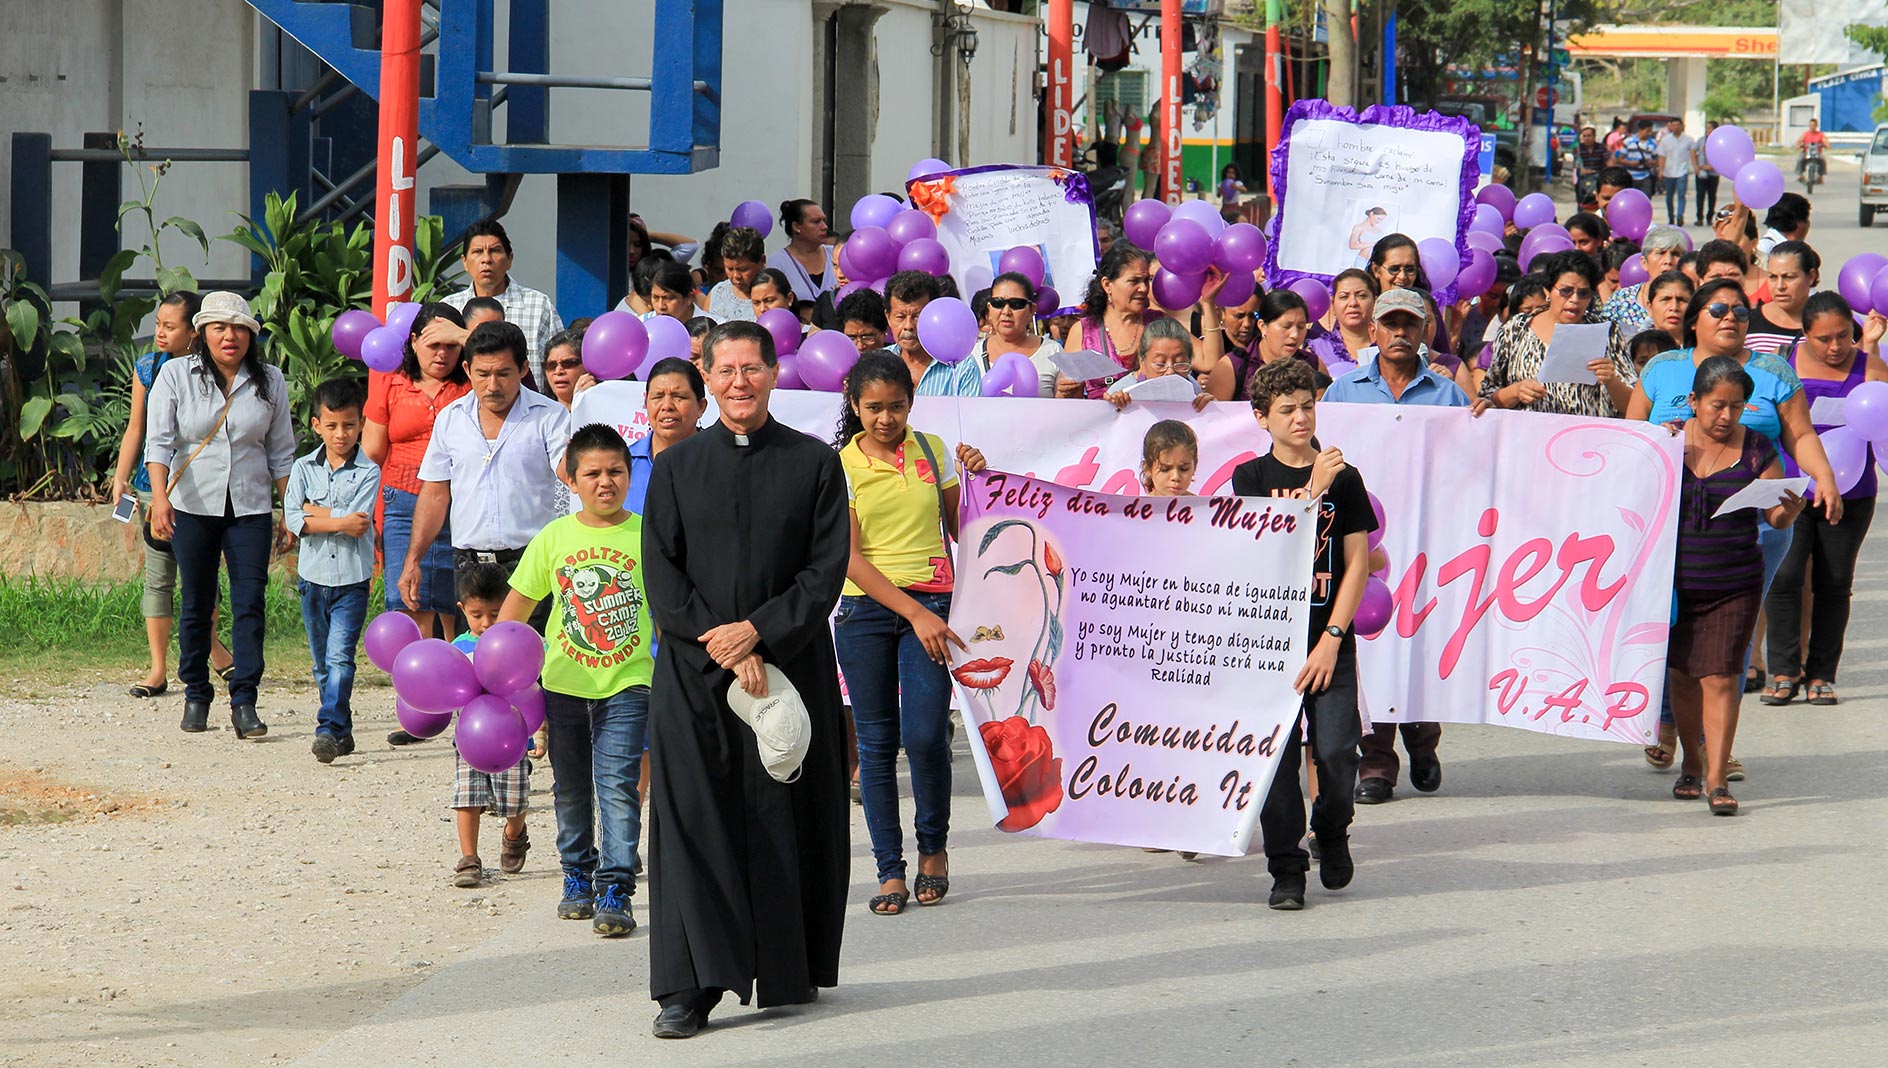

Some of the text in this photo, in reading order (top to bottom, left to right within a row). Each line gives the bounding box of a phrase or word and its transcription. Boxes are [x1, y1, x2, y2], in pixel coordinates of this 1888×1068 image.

[1337, 131, 1374, 153] hombre
[985, 474, 1053, 519] Feliz
[1123, 498, 1153, 521] de
[1166, 498, 1194, 525] la
[1208, 496, 1297, 541] Mujer
[565, 547, 637, 571] BOLTZ'S
[1071, 567, 1307, 603] Yo soy Mujer en busca de igualdad
[1361, 507, 1628, 681] ujer
[583, 588, 643, 615] SUMMER
[597, 606, 640, 627] CAMP
[1081, 592, 1293, 623] no aguantaré abuso ni maldad,
[604, 619, 639, 641] 2012
[1078, 621, 1291, 653] yo soy Mujer y tengo dignidad
[557, 629, 641, 668] TAEKWONDO
[1075, 641, 1285, 672] y pronto la Justicia será una
[1151, 668, 1211, 686] Realidad
[755, 698, 780, 722] ORACLE
[1088, 702, 1280, 757] Comunidad
[1068, 755, 1198, 805] Colonia
